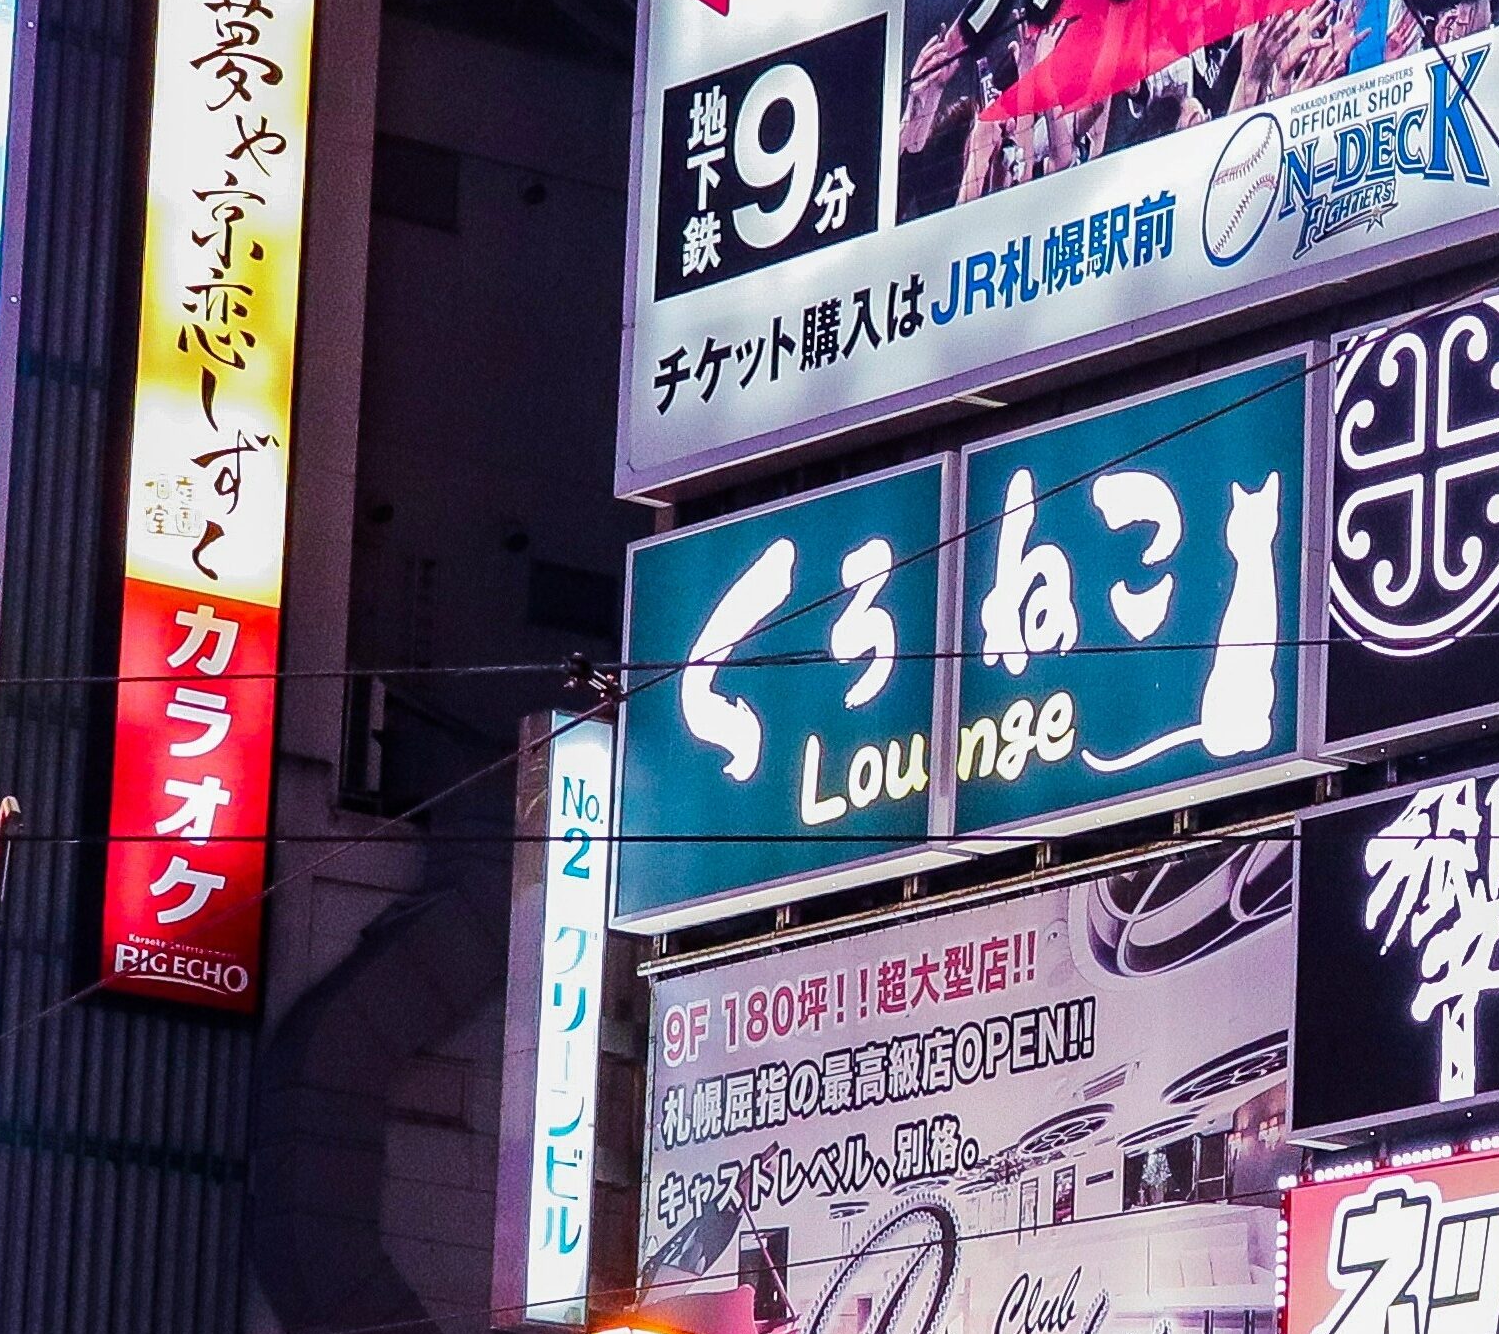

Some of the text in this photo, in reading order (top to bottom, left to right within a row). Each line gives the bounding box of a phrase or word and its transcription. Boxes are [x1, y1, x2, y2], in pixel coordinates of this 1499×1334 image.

[1278, 41, 1491, 220] N-DECK
[1290, 81, 1413, 139] OFFICIAL SHOP
[1291, 94, 1328, 115] HOKKAIDO
[682, 62, 856, 276] 地下鉄 9分
[152, 604, 239, 925] カラオケ
[800, 690, 1076, 826] Lounge
[114, 943, 248, 995] BIG ECHO
[662, 1006, 711, 1063] 9F
